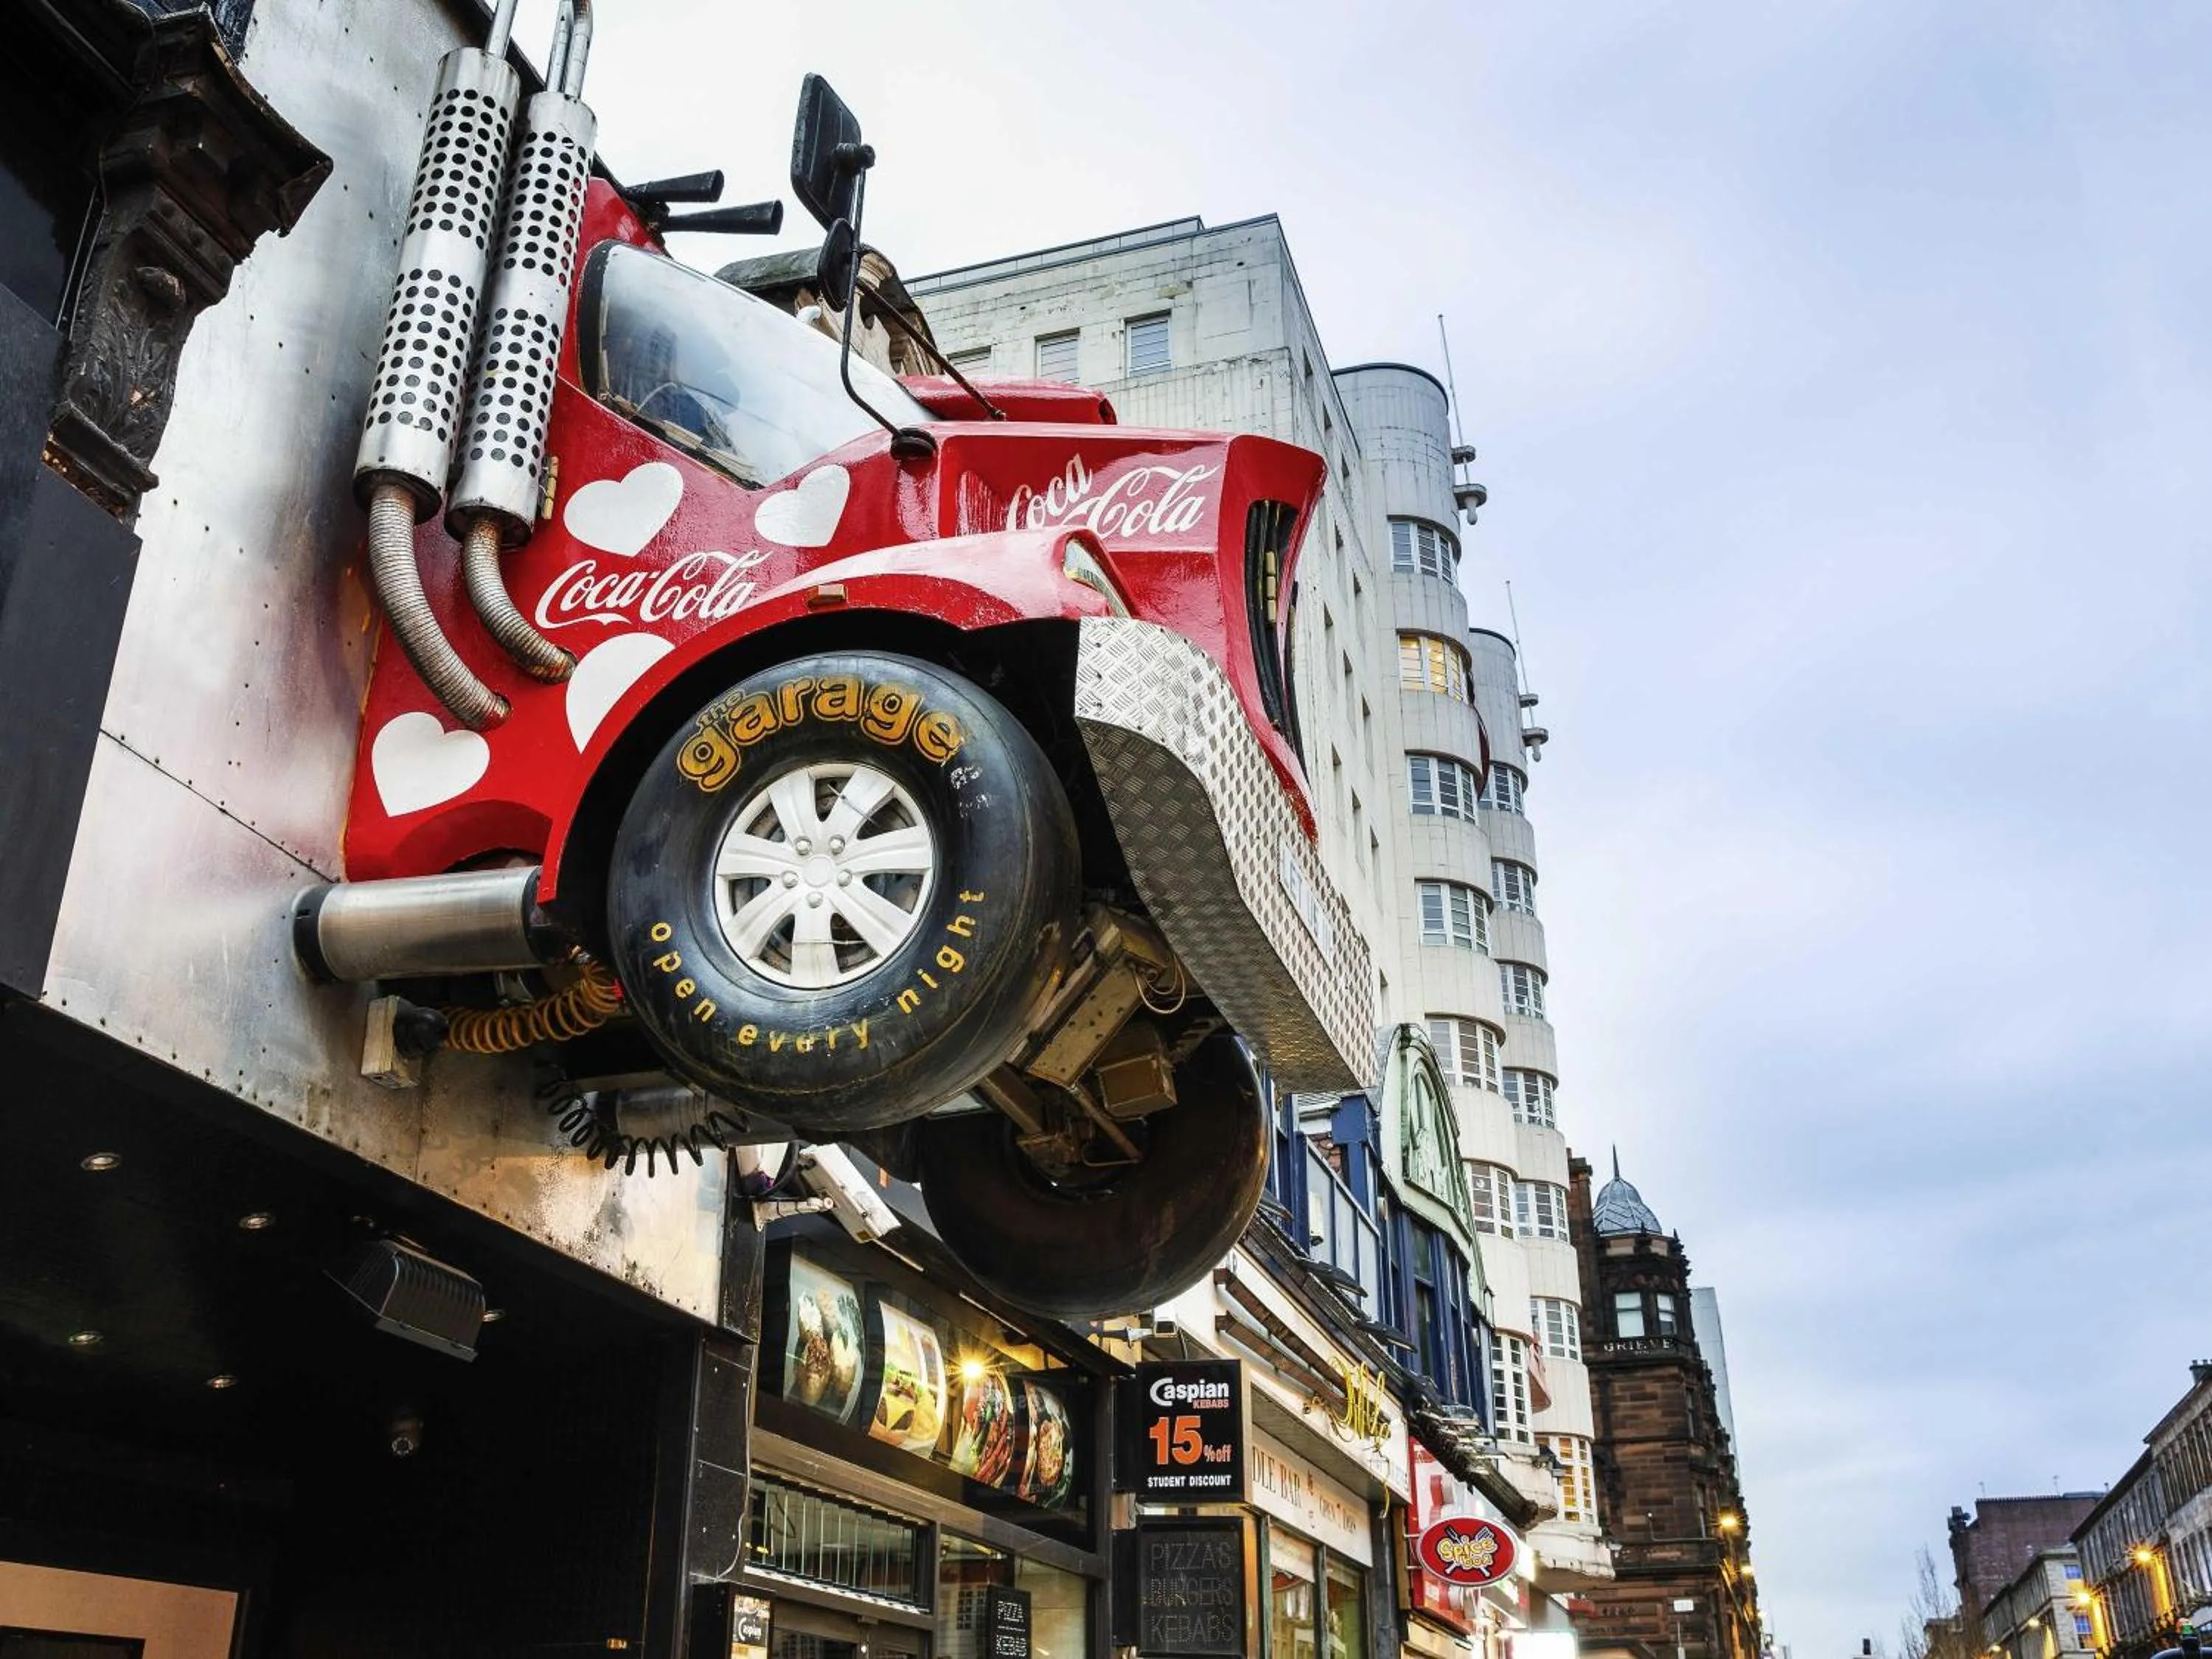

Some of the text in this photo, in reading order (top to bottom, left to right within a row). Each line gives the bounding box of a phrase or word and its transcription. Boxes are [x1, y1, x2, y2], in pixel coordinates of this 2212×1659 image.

[535, 549, 773, 628] Coca-Cola
[696, 688, 745, 726] the
[676, 675, 967, 792] garage
[650, 889, 985, 1052] open every night
[1150, 1377, 1229, 1407] Caspian
[1192, 1399, 1229, 1409] KEBABS
[1150, 1416, 1203, 1465] 15
[1147, 1475, 1231, 1488] STUDENT DISCOUNT
[1279, 1464, 1302, 1509] BAR
[1151, 1542, 1232, 1571] PIZZAS
[1437, 1535, 1498, 1562] Spice
[1151, 1576, 1234, 1606] BURGERS
[998, 1601, 1024, 1623] PIZZA
[1151, 1615, 1234, 1643] KEBABS
